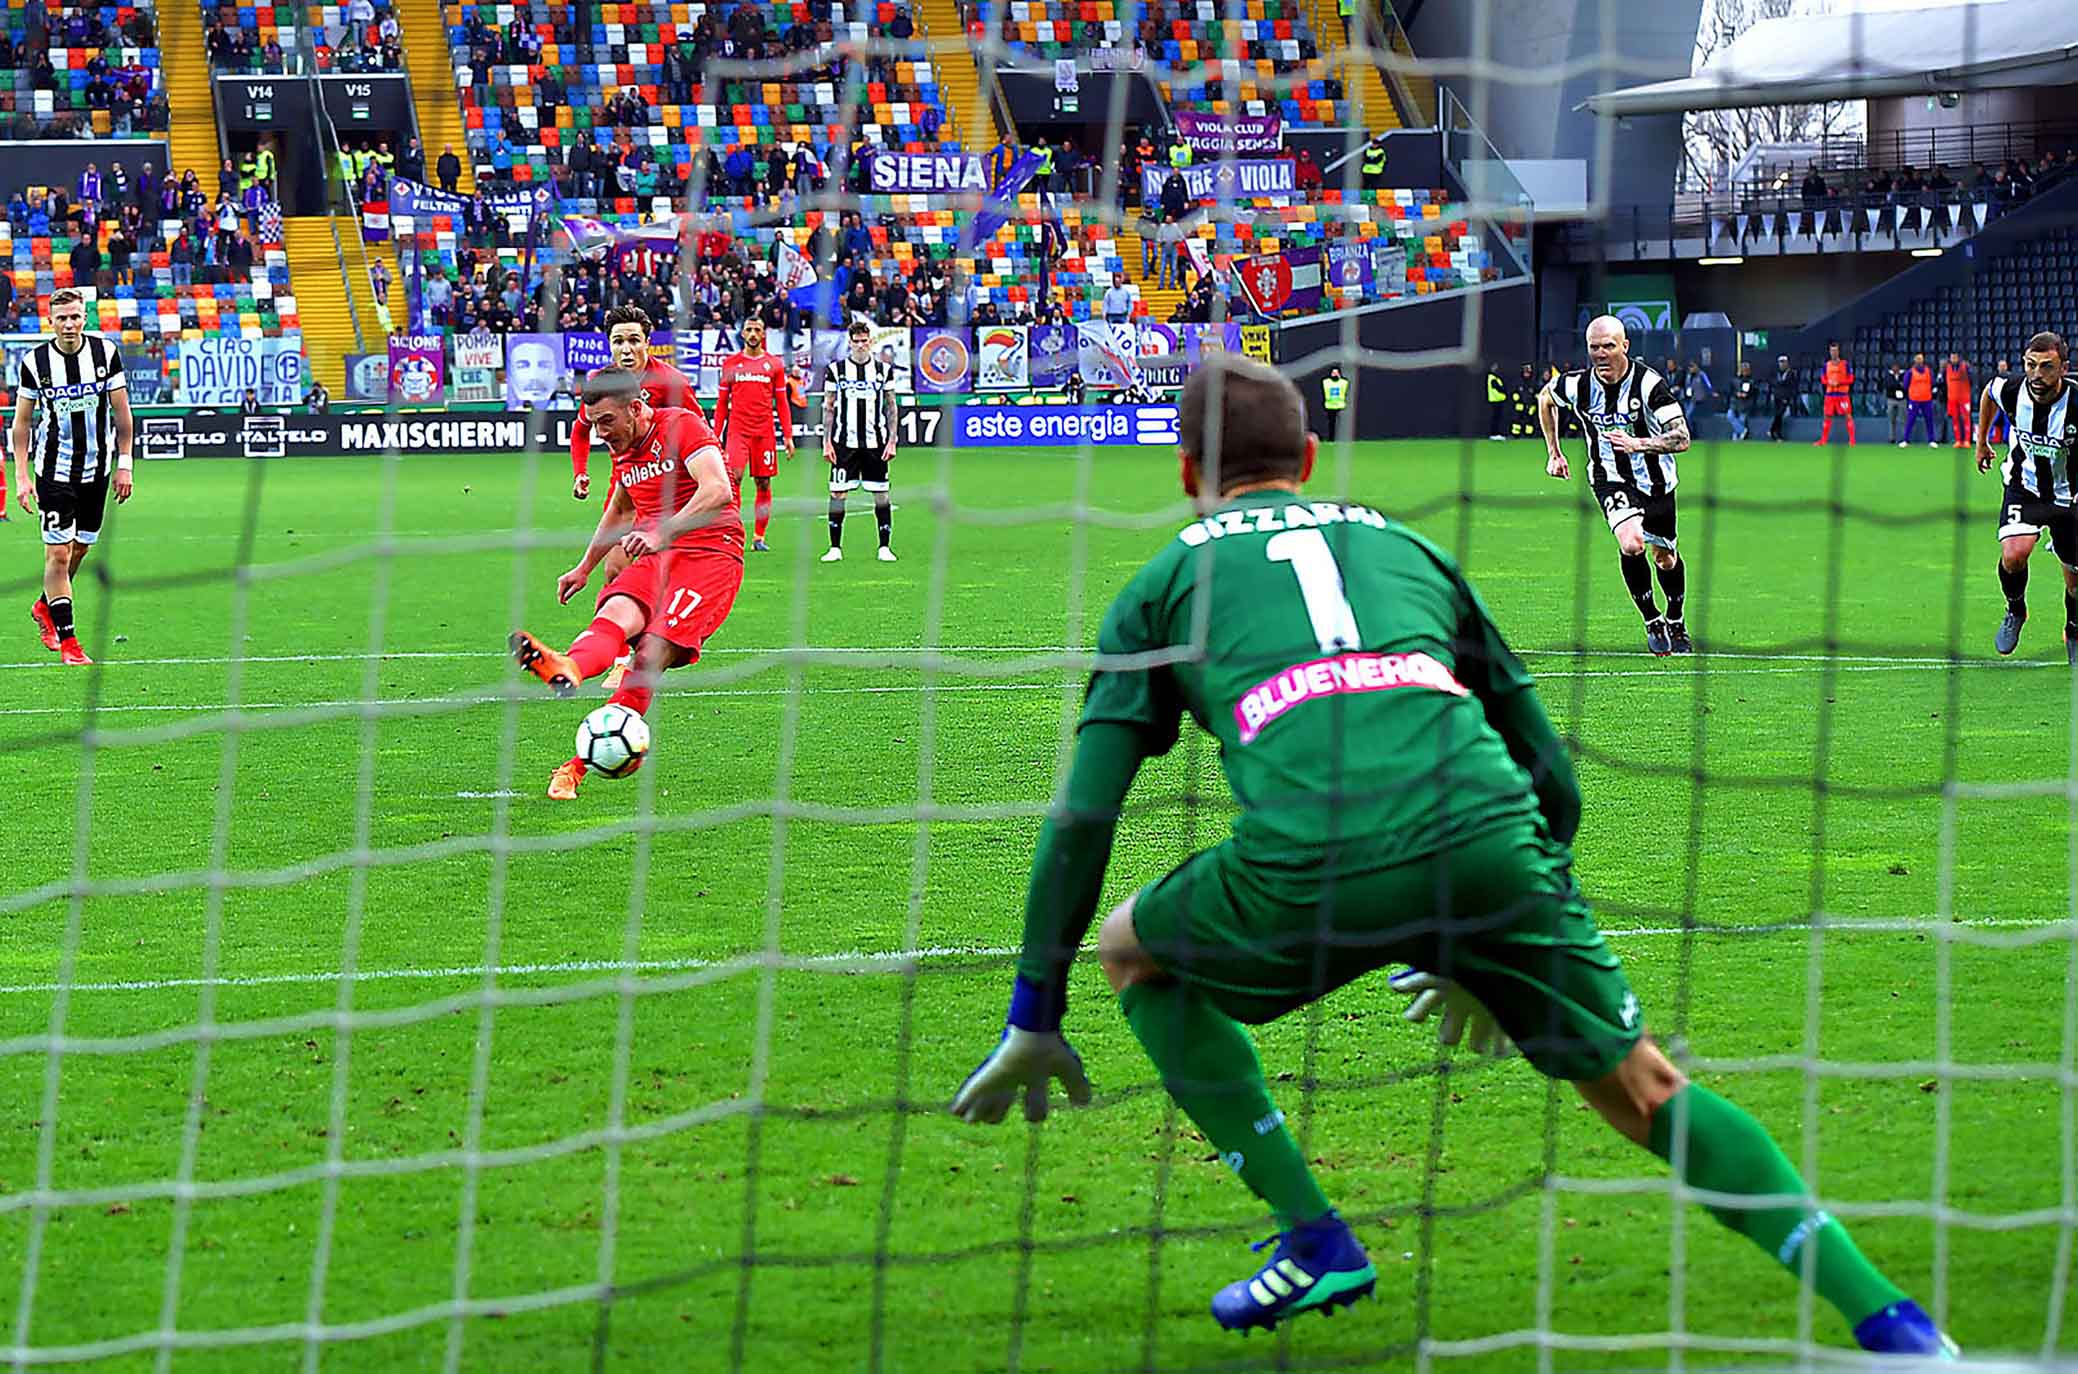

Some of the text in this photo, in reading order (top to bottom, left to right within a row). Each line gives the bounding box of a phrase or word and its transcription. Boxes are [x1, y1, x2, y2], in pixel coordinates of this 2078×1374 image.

[247, 86, 273, 99] V14
[345, 84, 371, 97] V15
[1185, 137, 1234, 151] TAGGIA
[873, 154, 988, 189] SIENA
[1240, 163, 1292, 191] VIOLA
[200, 338, 252, 354] CIAO
[456, 335, 499, 350] POMPA
[464, 351, 492, 365] VIVE
[186, 354, 274, 388] DAVIDE
[44, 384, 95, 399] DACIA
[341, 421, 525, 449] MAXISCHERMI
[901, 410, 941, 443] 17
[965, 408, 1129, 441] aste energia
[831, 467, 847, 484] 10
[1604, 490, 1630, 515] 23
[2007, 504, 2022, 524] 5
[1266, 527, 1363, 654] 1
[666, 587, 703, 620] 17
